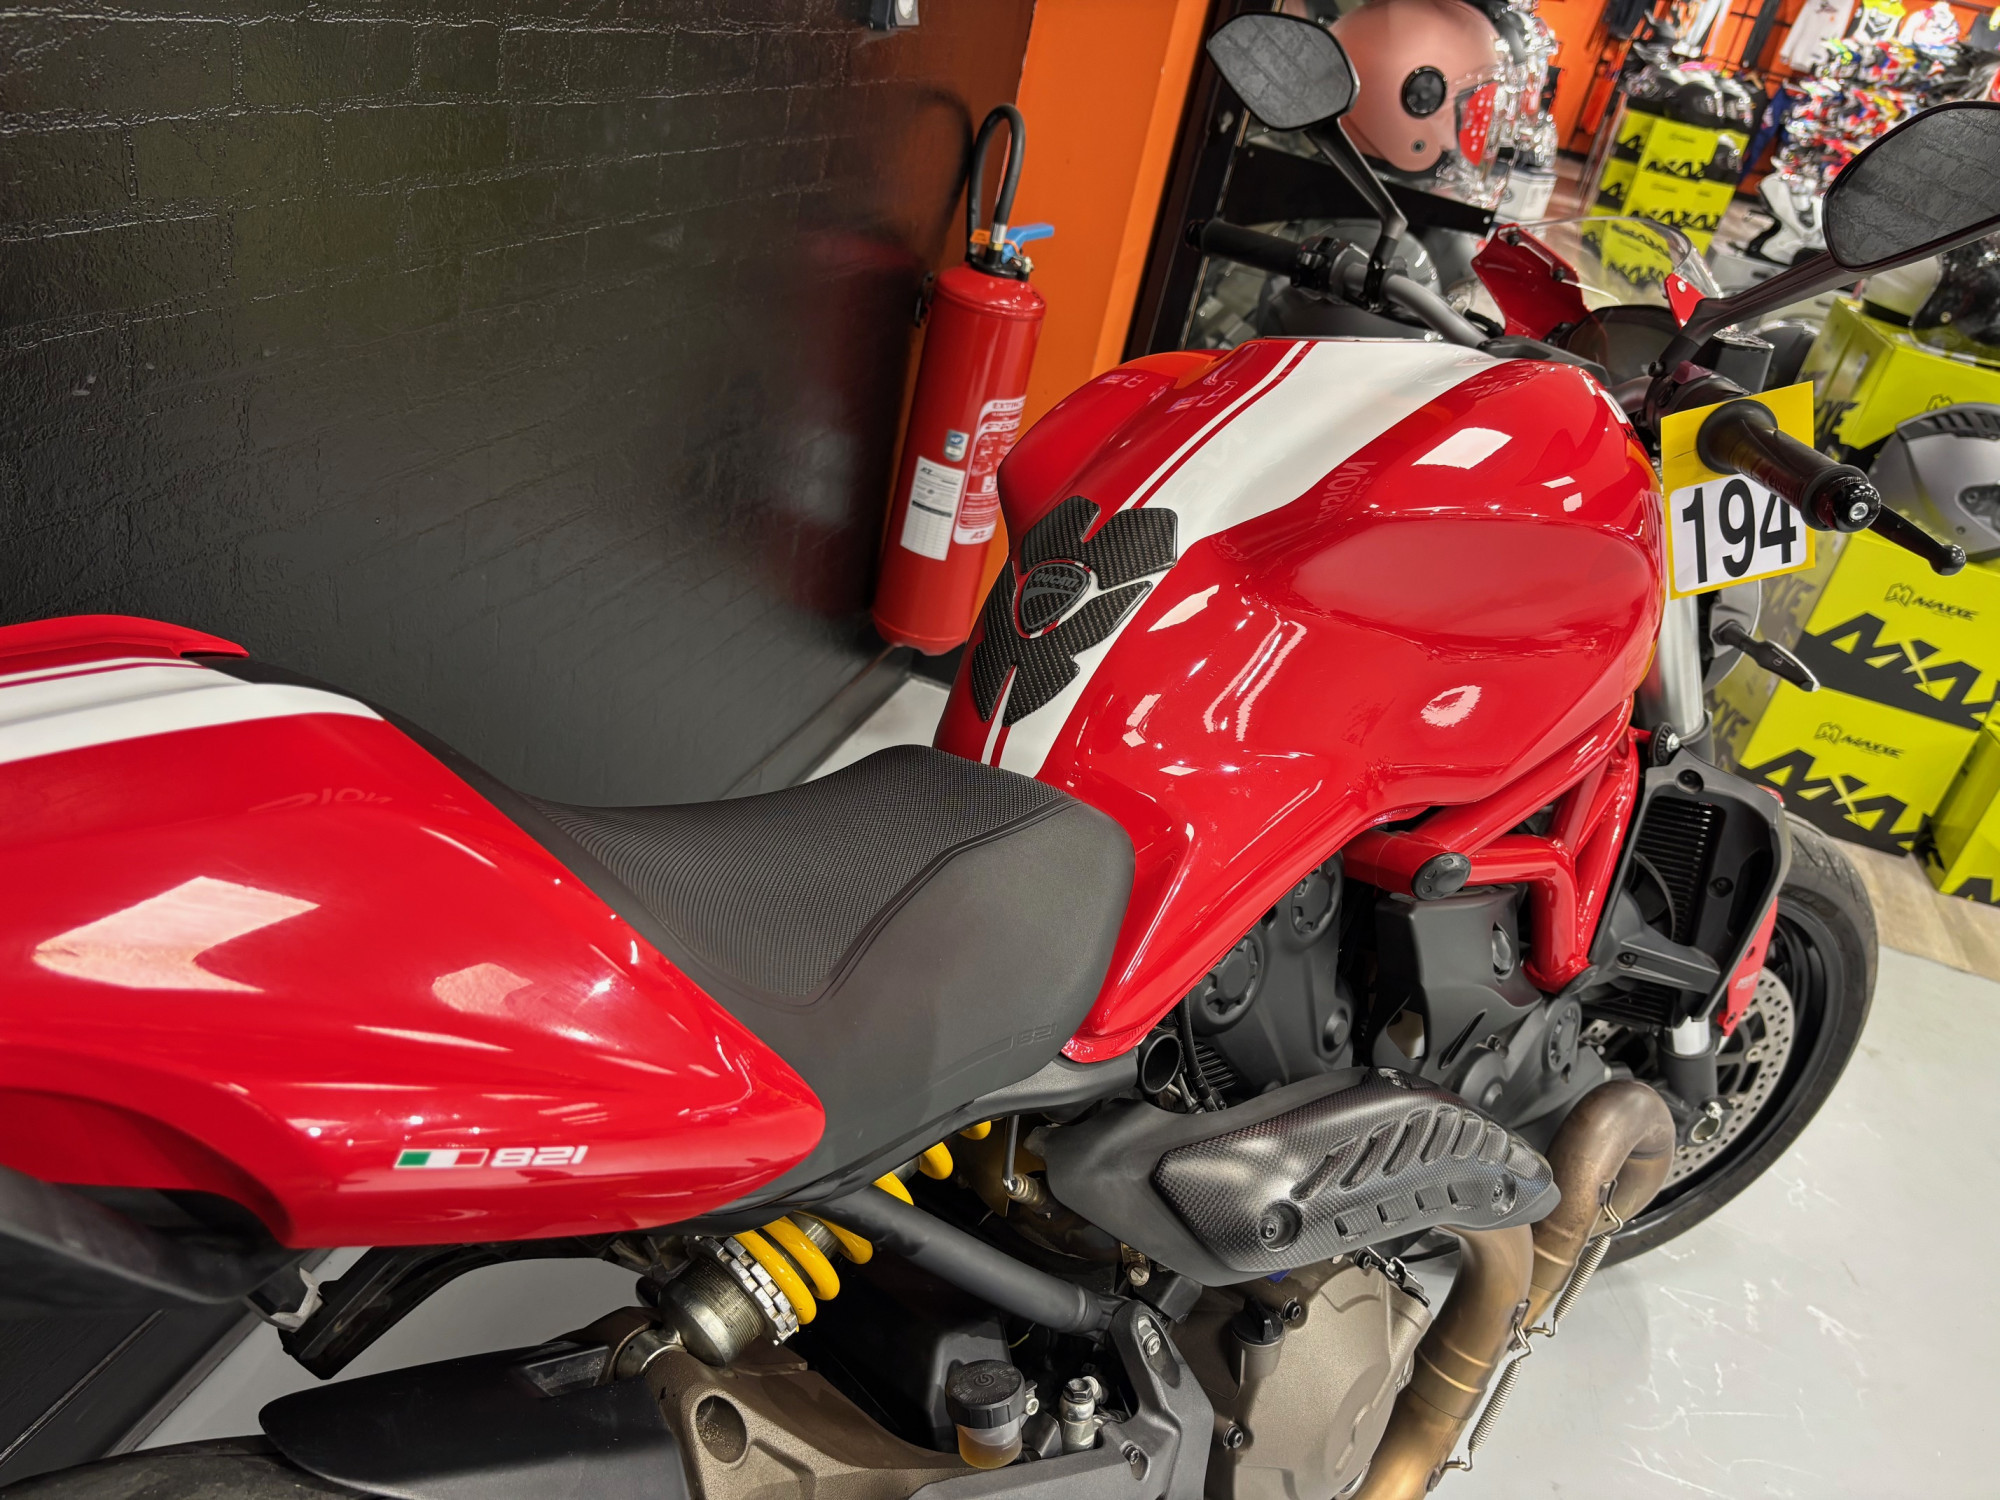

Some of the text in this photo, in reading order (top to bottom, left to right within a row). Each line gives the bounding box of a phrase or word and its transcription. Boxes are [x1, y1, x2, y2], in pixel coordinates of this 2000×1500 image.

[1681, 478, 1798, 584] 194
[1033, 572, 1080, 588] DUCATI
[490, 1145, 589, 1168] 821
